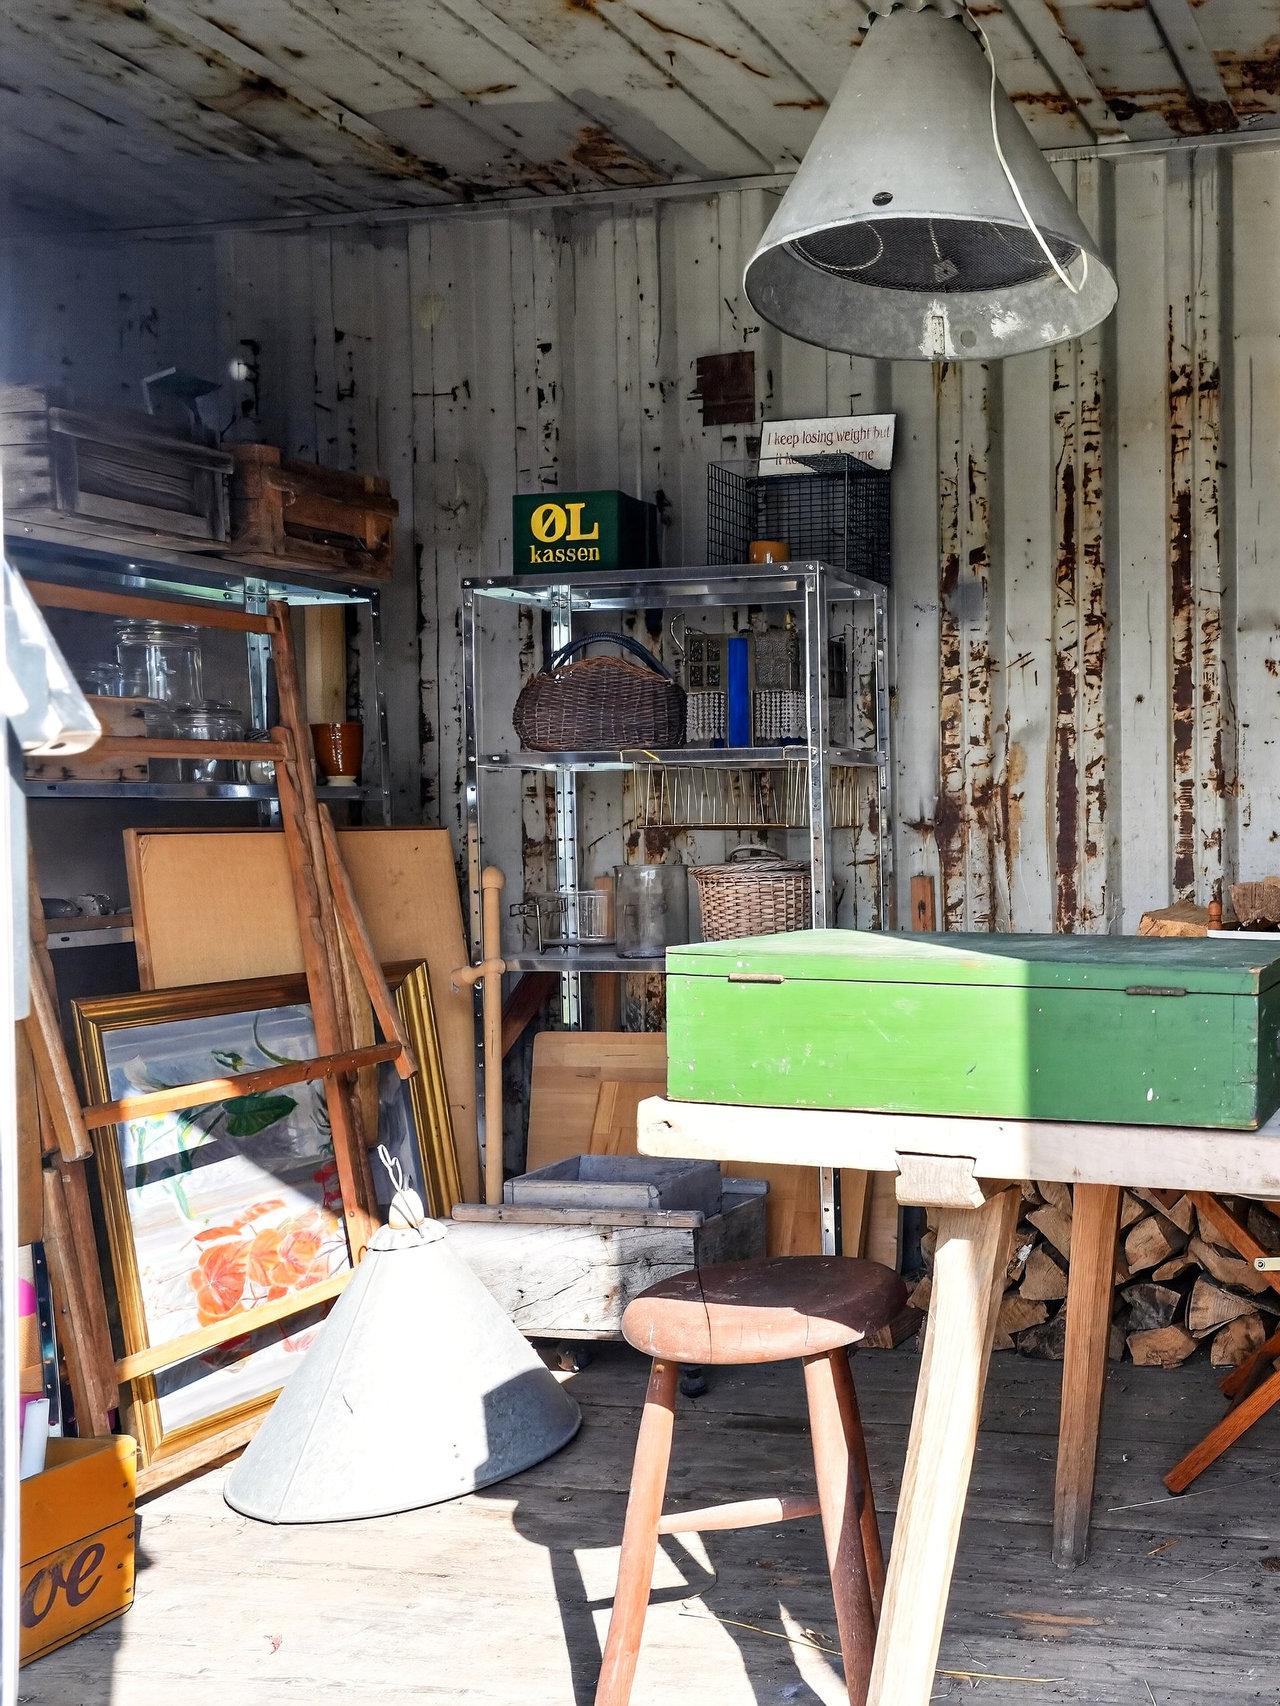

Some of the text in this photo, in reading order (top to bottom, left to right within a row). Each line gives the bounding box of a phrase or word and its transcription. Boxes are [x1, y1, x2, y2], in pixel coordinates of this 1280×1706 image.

[774, 432, 800, 447] keep
[802, 429, 834, 446] losing
[836, 426, 871, 444] weight
[873, 425, 891, 438] but
[857, 449, 875, 461] me
[530, 502, 600, 543] ØL
[529, 545, 601, 563] kassen
